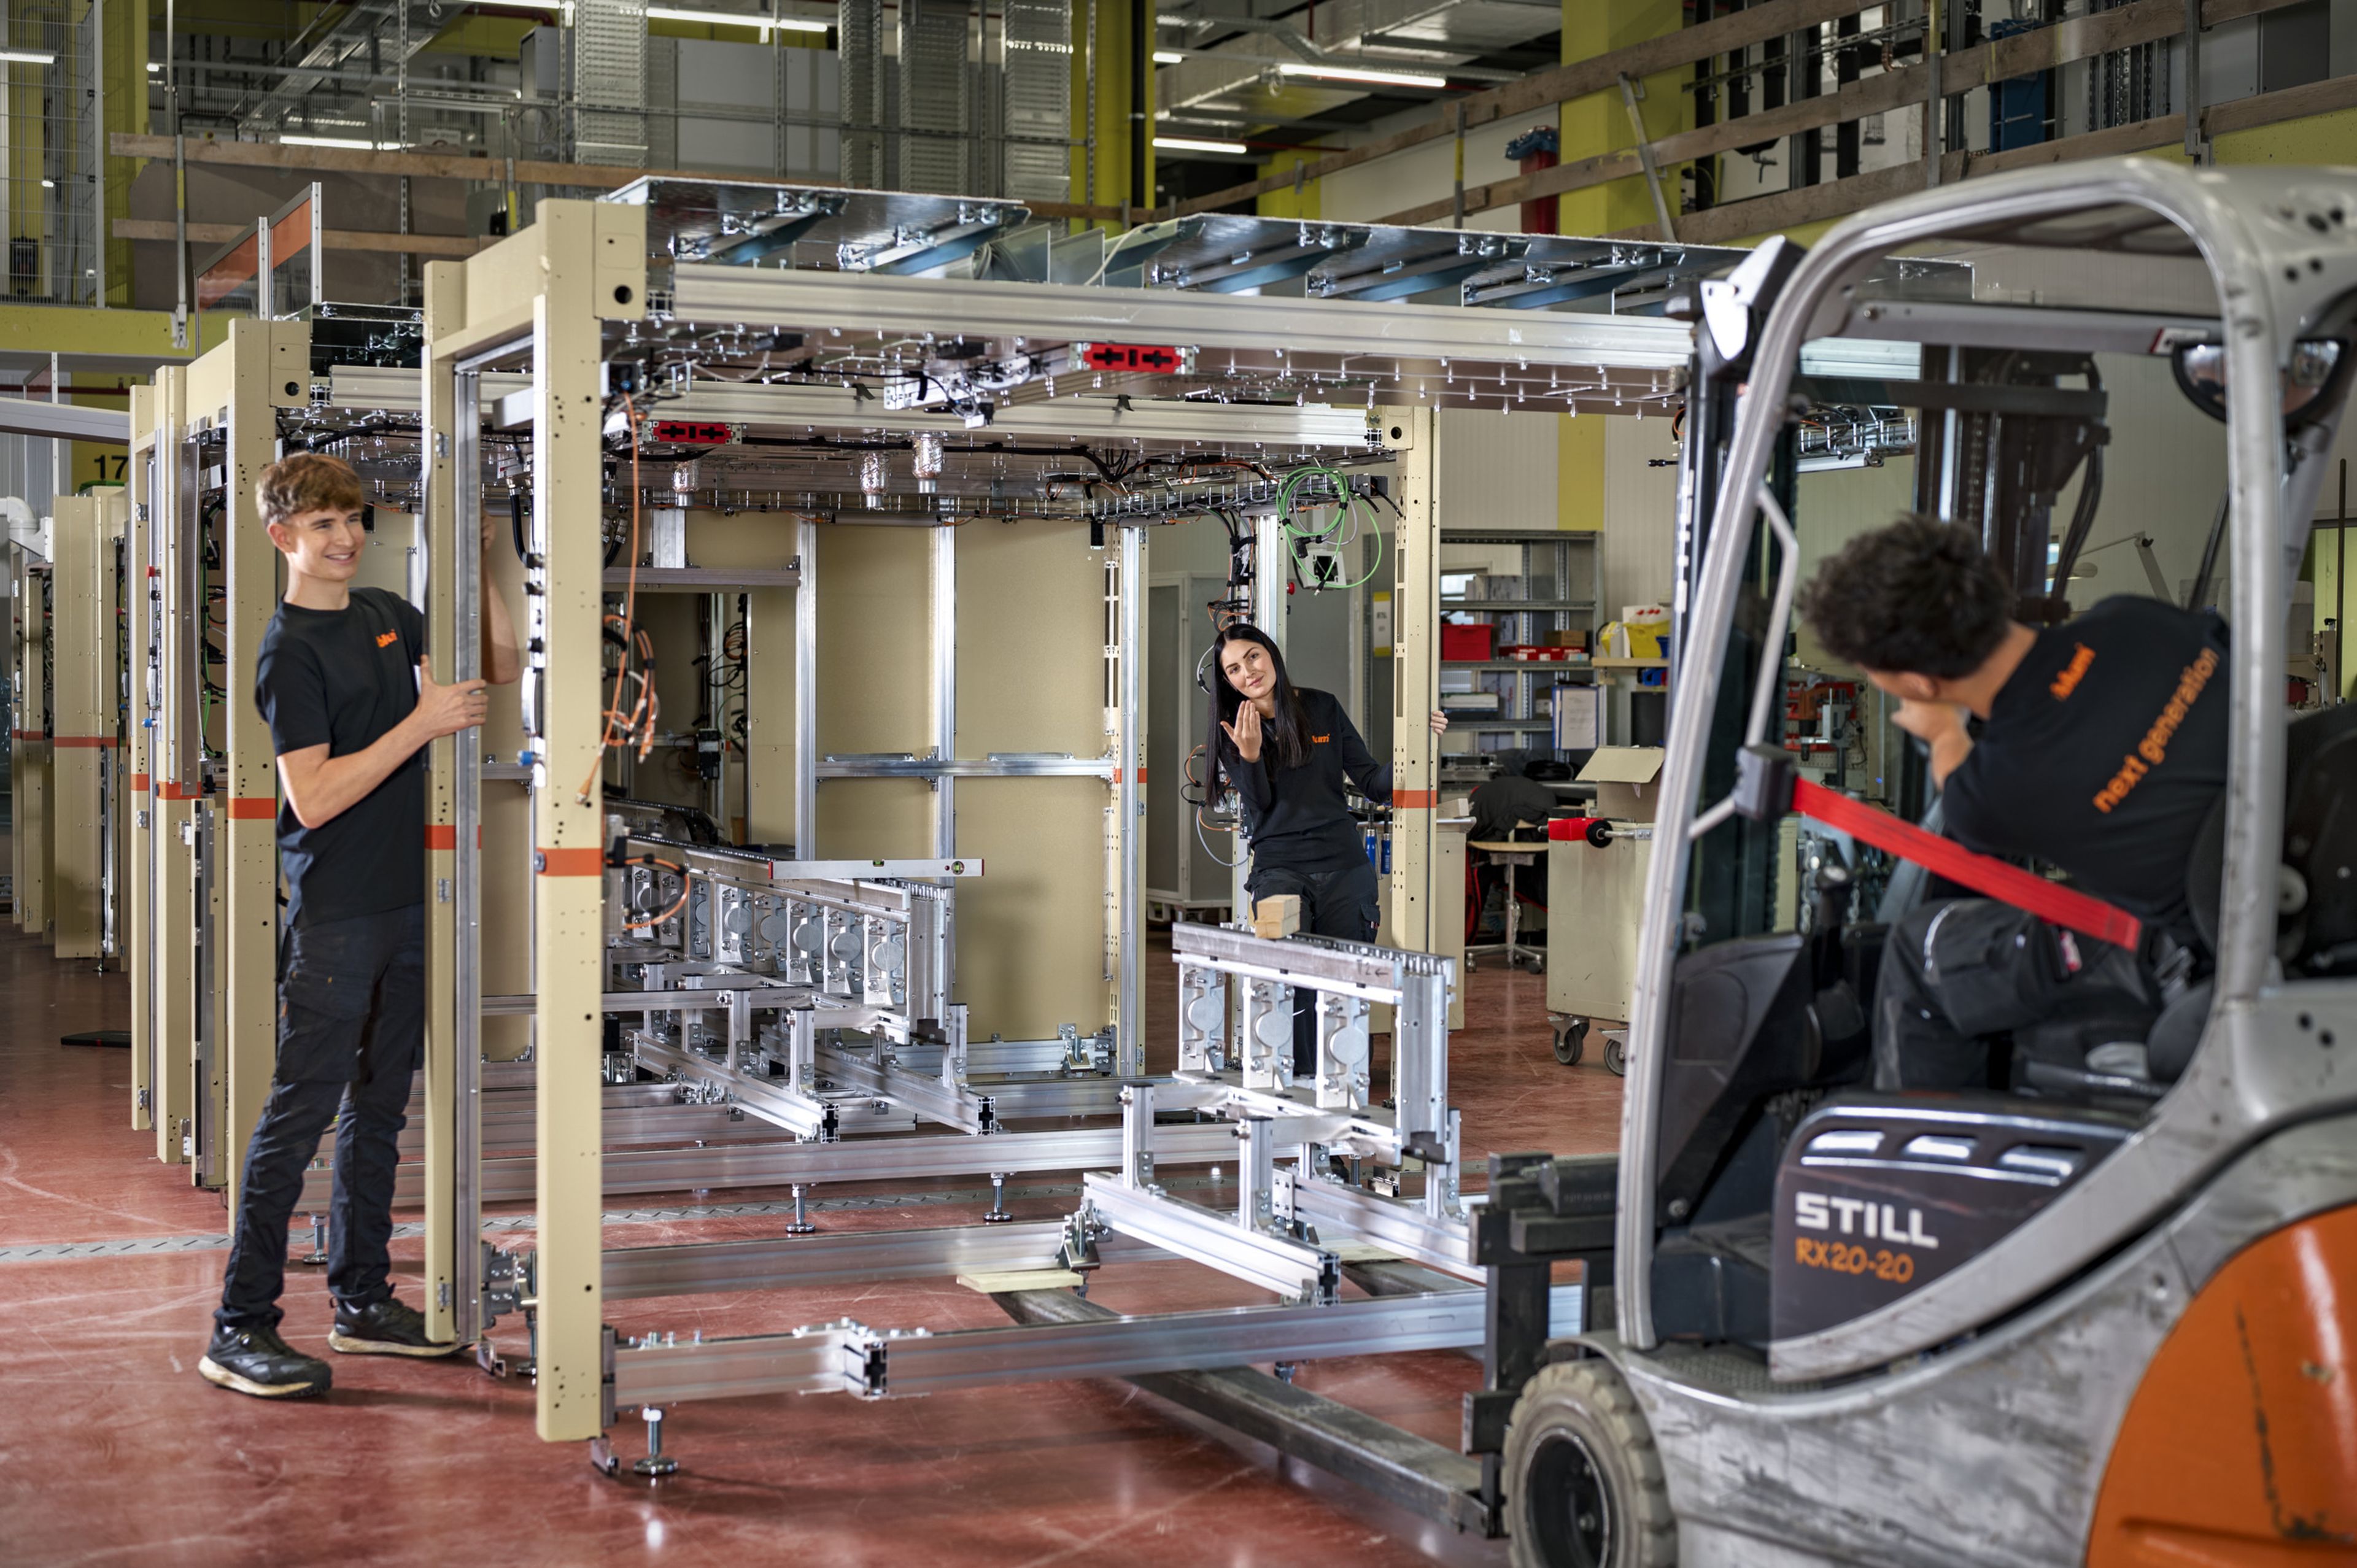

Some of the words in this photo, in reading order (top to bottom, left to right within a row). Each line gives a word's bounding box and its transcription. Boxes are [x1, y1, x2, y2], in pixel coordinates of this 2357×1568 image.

[94, 455, 129, 480] 17
[2092, 754, 2149, 814] next
[2138, 646, 2220, 765] generation
[1795, 1191, 1939, 1249] STILL
[1795, 1236, 1914, 1284] RX20-20
